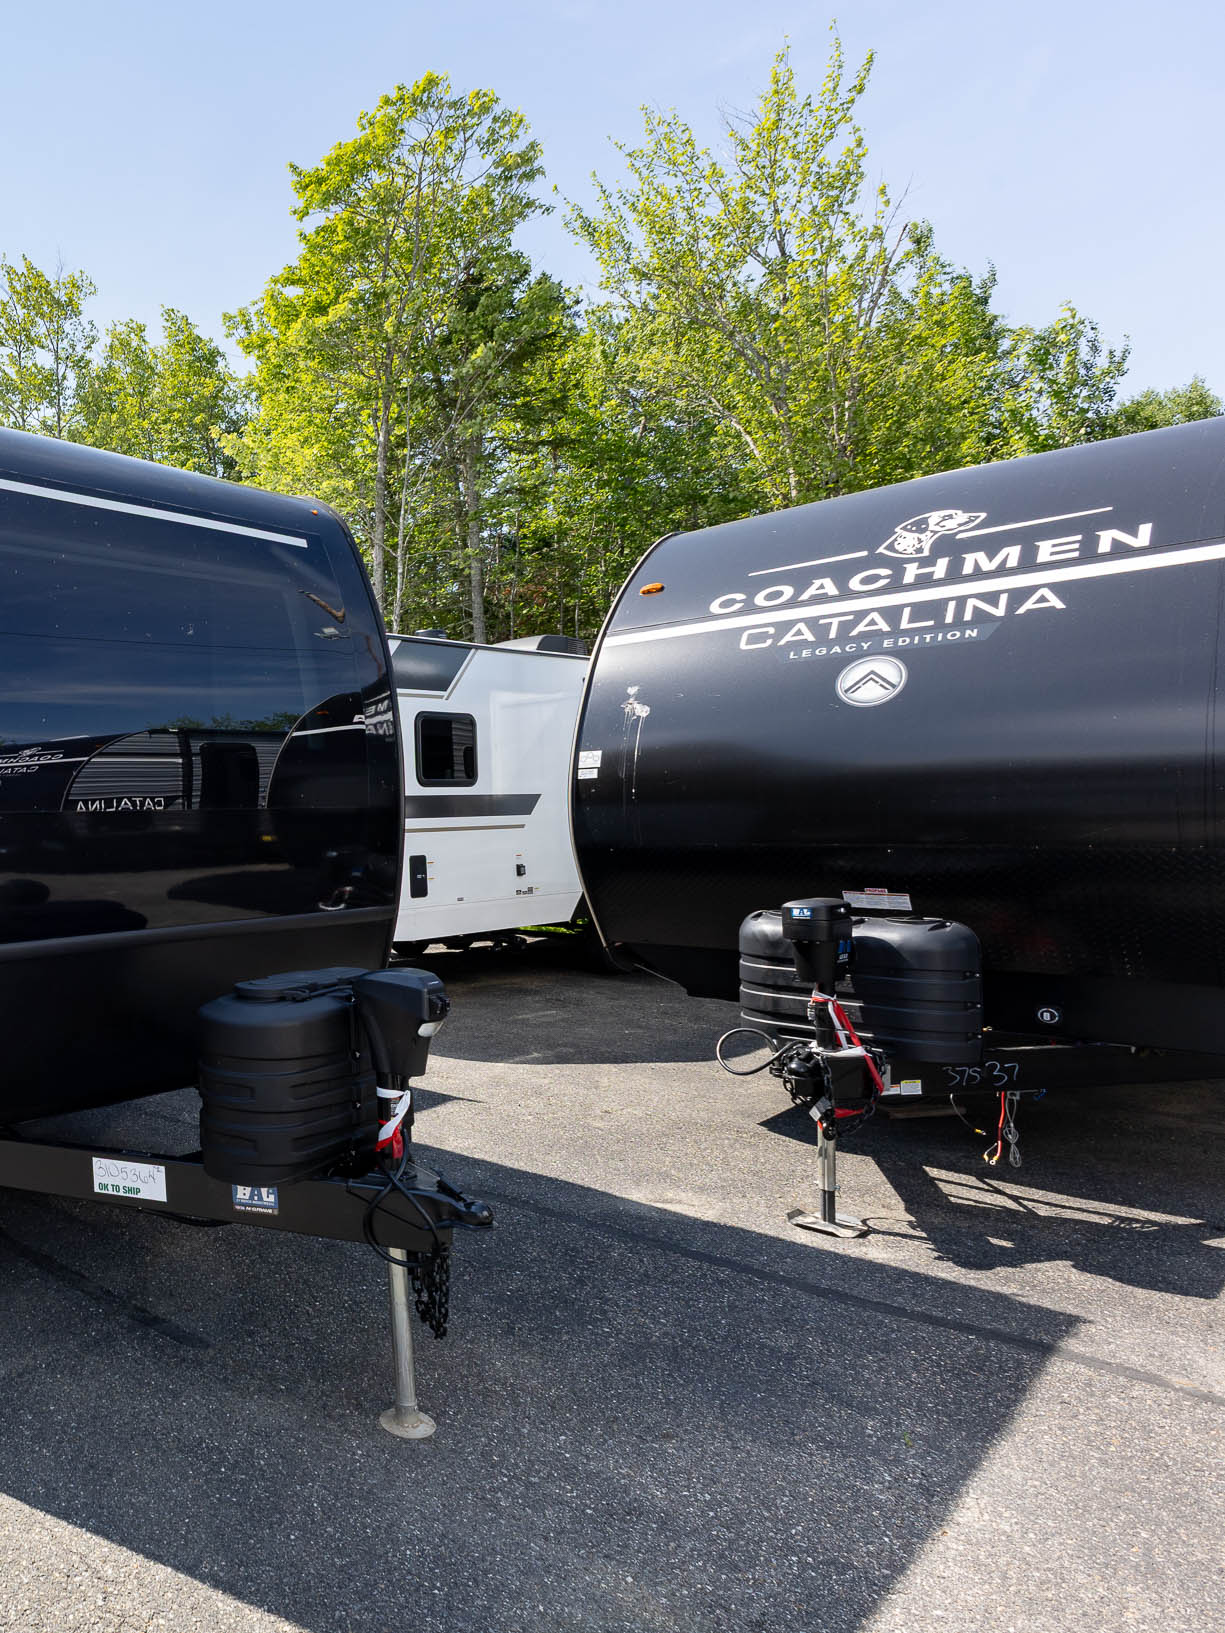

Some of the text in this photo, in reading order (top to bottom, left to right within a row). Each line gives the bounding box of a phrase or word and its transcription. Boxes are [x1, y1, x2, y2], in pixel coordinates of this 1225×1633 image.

[709, 522, 1154, 615] COACHMEN
[739, 587, 1067, 651] CATALINA
[788, 628, 979, 660] LEGACY EDITION
[98, 1182, 141, 1196] OK TO SHIP
